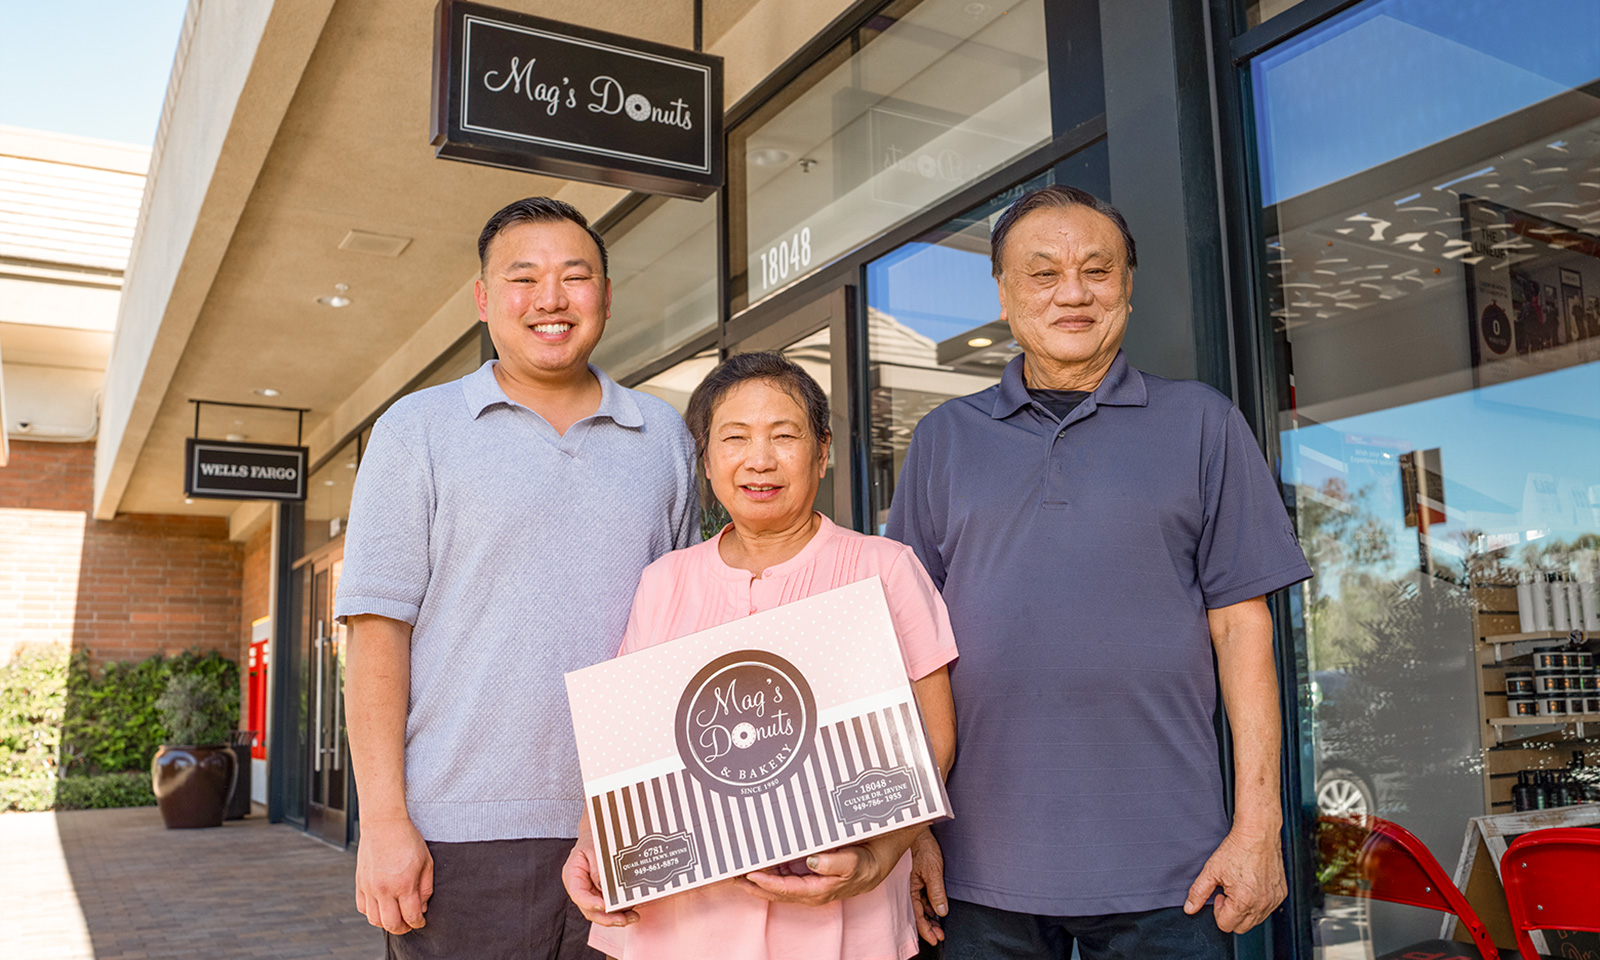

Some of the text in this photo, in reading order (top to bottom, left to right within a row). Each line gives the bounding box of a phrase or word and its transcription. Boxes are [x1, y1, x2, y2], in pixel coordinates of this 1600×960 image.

[483, 56, 693, 131] Mag's Donuts
[1481, 228, 1498, 244] THE
[760, 226, 811, 290] 18048
[200, 462, 297, 480] WELLS FARGO
[696, 678, 783, 727] Mag's
[699, 709, 794, 763] Donuts
[720, 743, 792, 780] & BAKERY
[740, 778, 780, 795] SINCE 1980
[843, 793, 871, 806] CULVER
[883, 782, 908, 795] IRVINE
[860, 778, 887, 794] 18048
[640, 858, 652, 866] HILL
[669, 847, 688, 857] IRVINE
[643, 845, 664, 858] 6781
